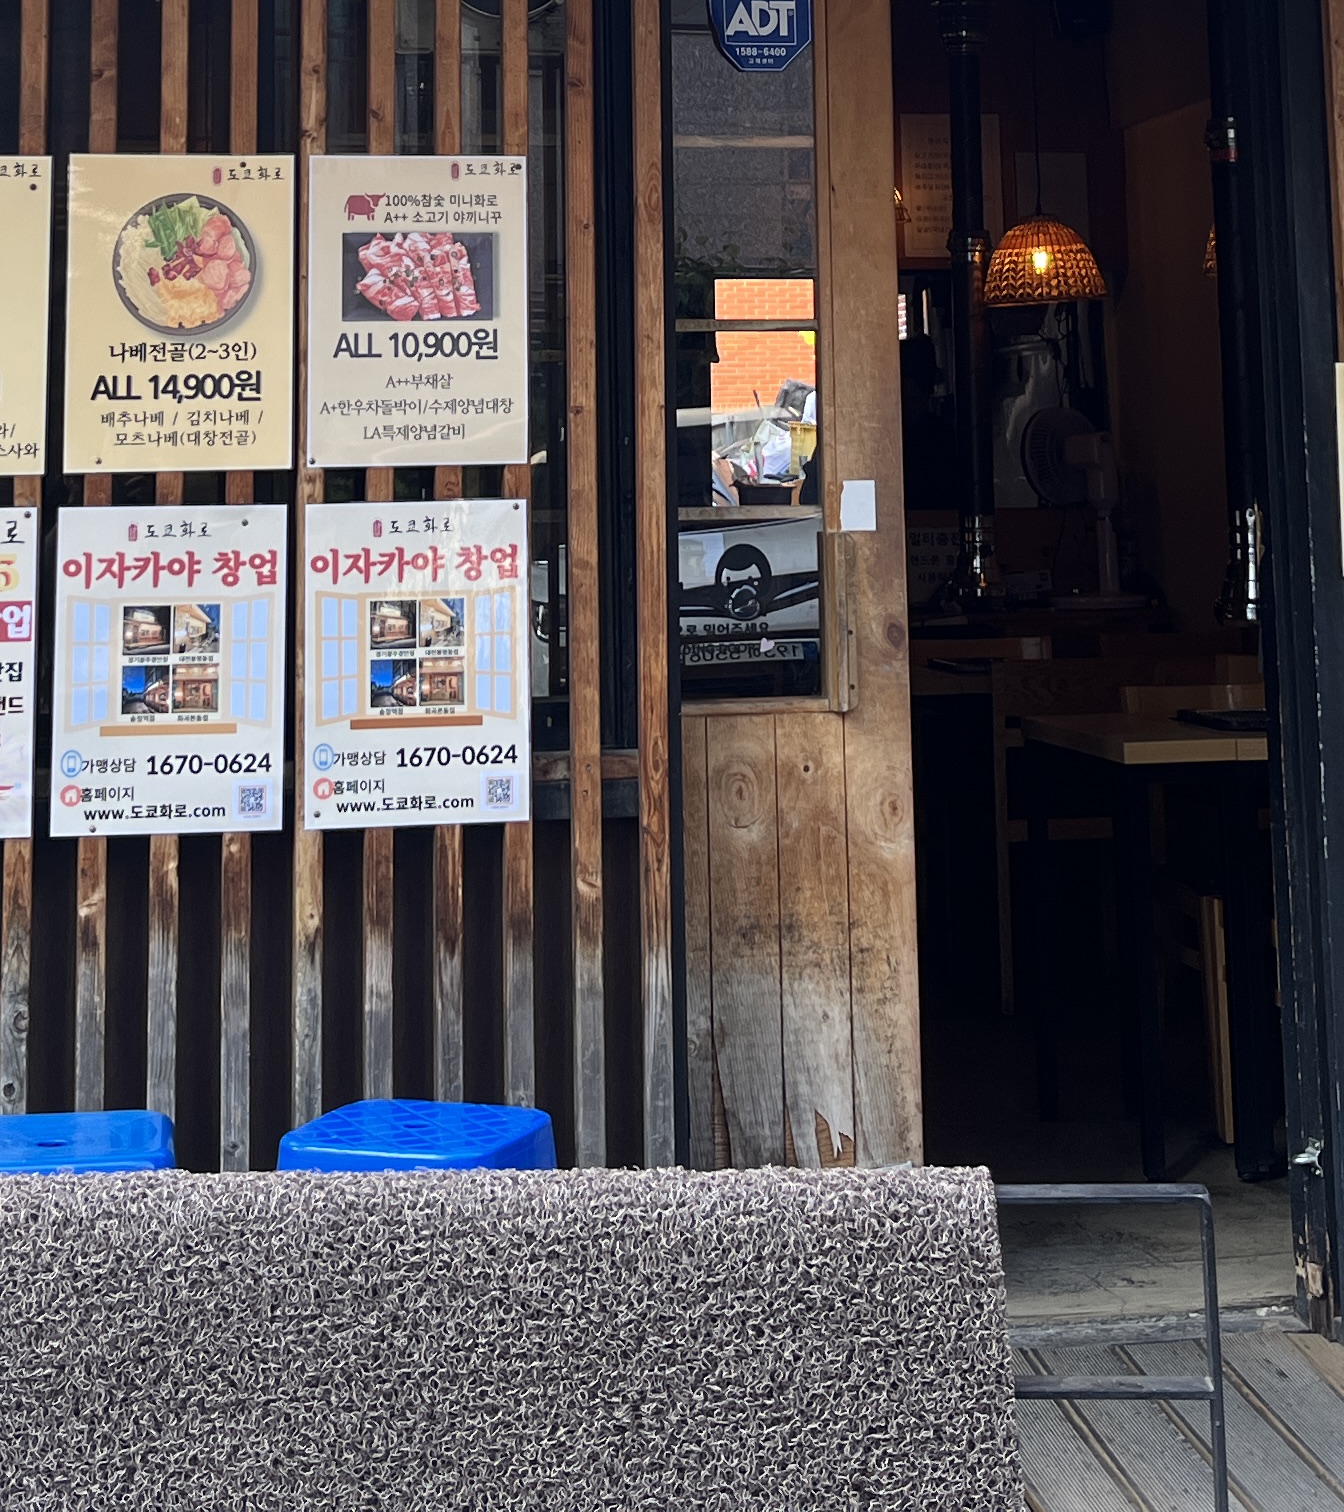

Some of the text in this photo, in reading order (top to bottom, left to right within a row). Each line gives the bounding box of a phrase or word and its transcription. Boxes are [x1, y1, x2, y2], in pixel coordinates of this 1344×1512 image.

[726, 0, 795, 36] ADT
[449, 194, 498, 207] 미니화로
[384, 211, 502, 224] A++ 소고기 야끼니꾸
[109, 341, 257, 363] 나베전골(2~3인)
[333, 329, 498, 362] ALL 10,900원
[90, 370, 261, 403] ALL 14,900원
[386, 374, 453, 389] A++부채살
[101, 411, 164, 427] 배추나베
[187, 410, 249, 426] 김치나베
[114, 430, 257, 447] 모츠나베(대창전골)
[363, 424, 465, 440] LA특제양념갈비
[63, 549, 278, 588] 이자카야 창업
[310, 543, 519, 585] 이자카야 창업
[81, 752, 272, 776] 가맹상담 1670-0624
[333, 744, 518, 769] 가맹상담 1670-0624
[80, 785, 135, 802] 홈페이지
[333, 778, 385, 795] 홈페이지
[84, 802, 226, 821] www.도쿄화로.com
[336, 794, 474, 813] www.도쿄화로.com
